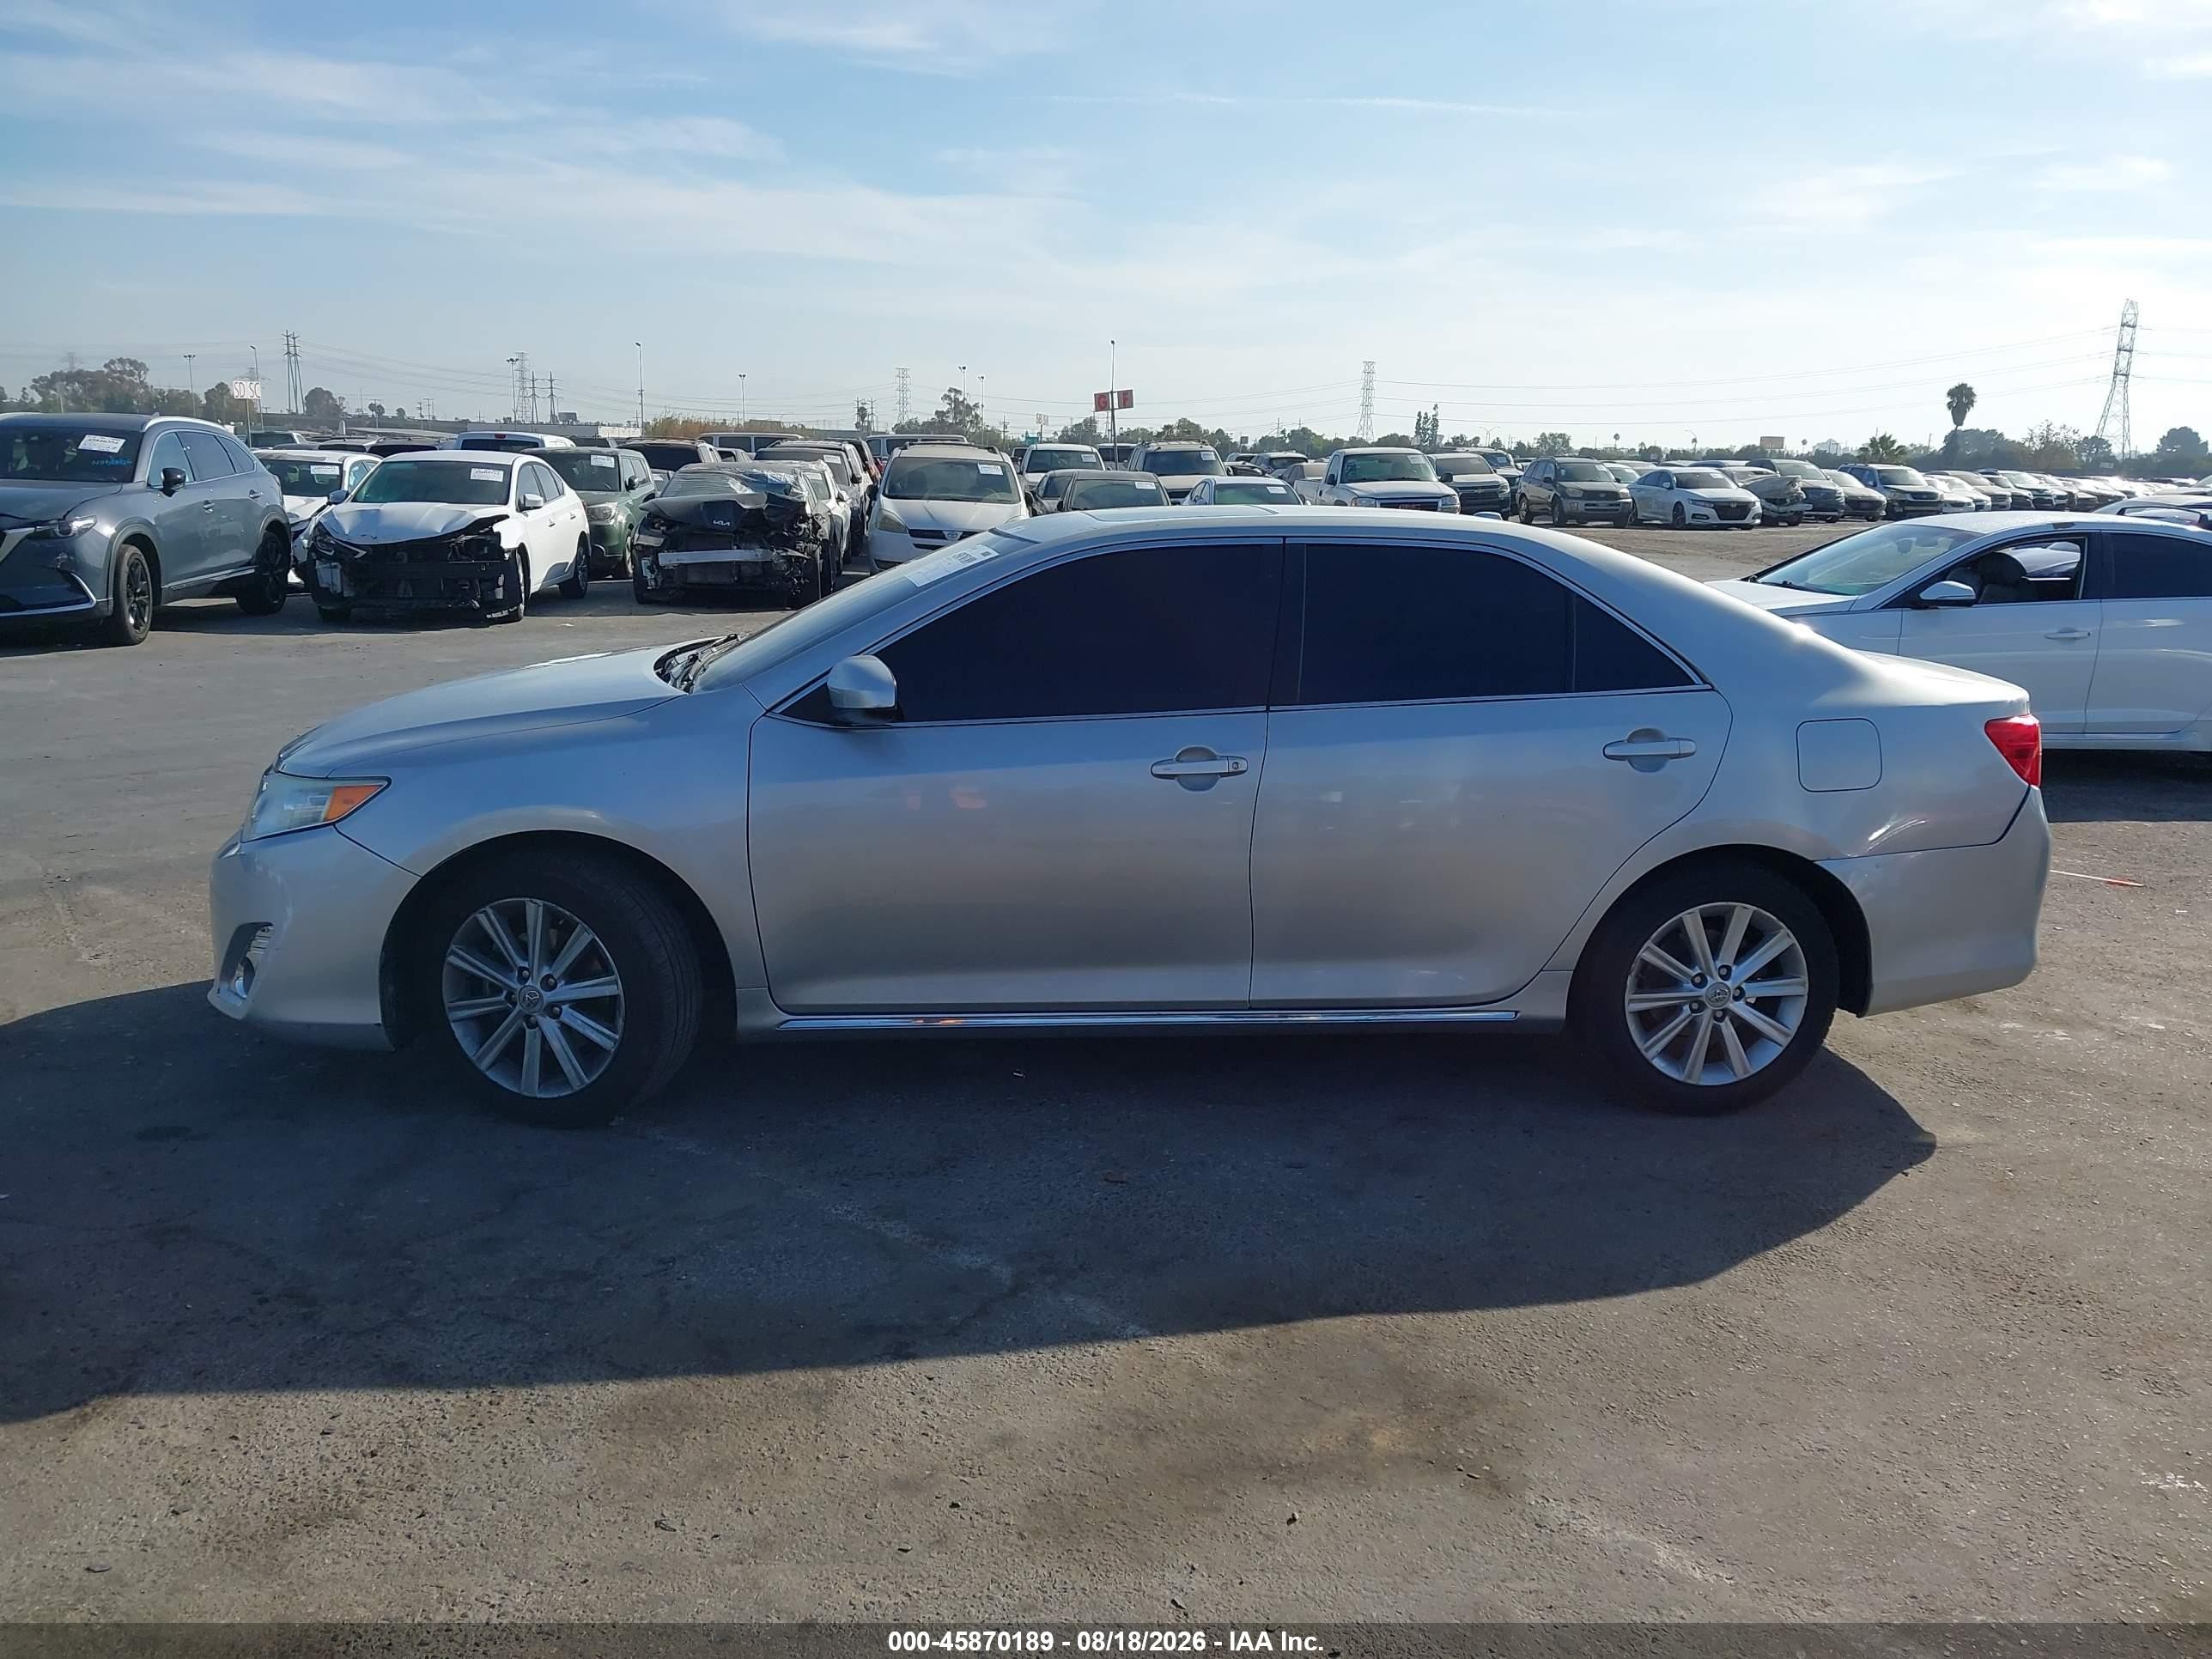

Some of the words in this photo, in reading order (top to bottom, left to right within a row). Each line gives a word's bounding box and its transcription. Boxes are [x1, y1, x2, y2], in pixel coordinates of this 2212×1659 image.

[234, 382, 246, 398] SD
[249, 382, 261, 398] SC
[1097, 394, 1108, 410] G
[1121, 392, 1129, 407] F
